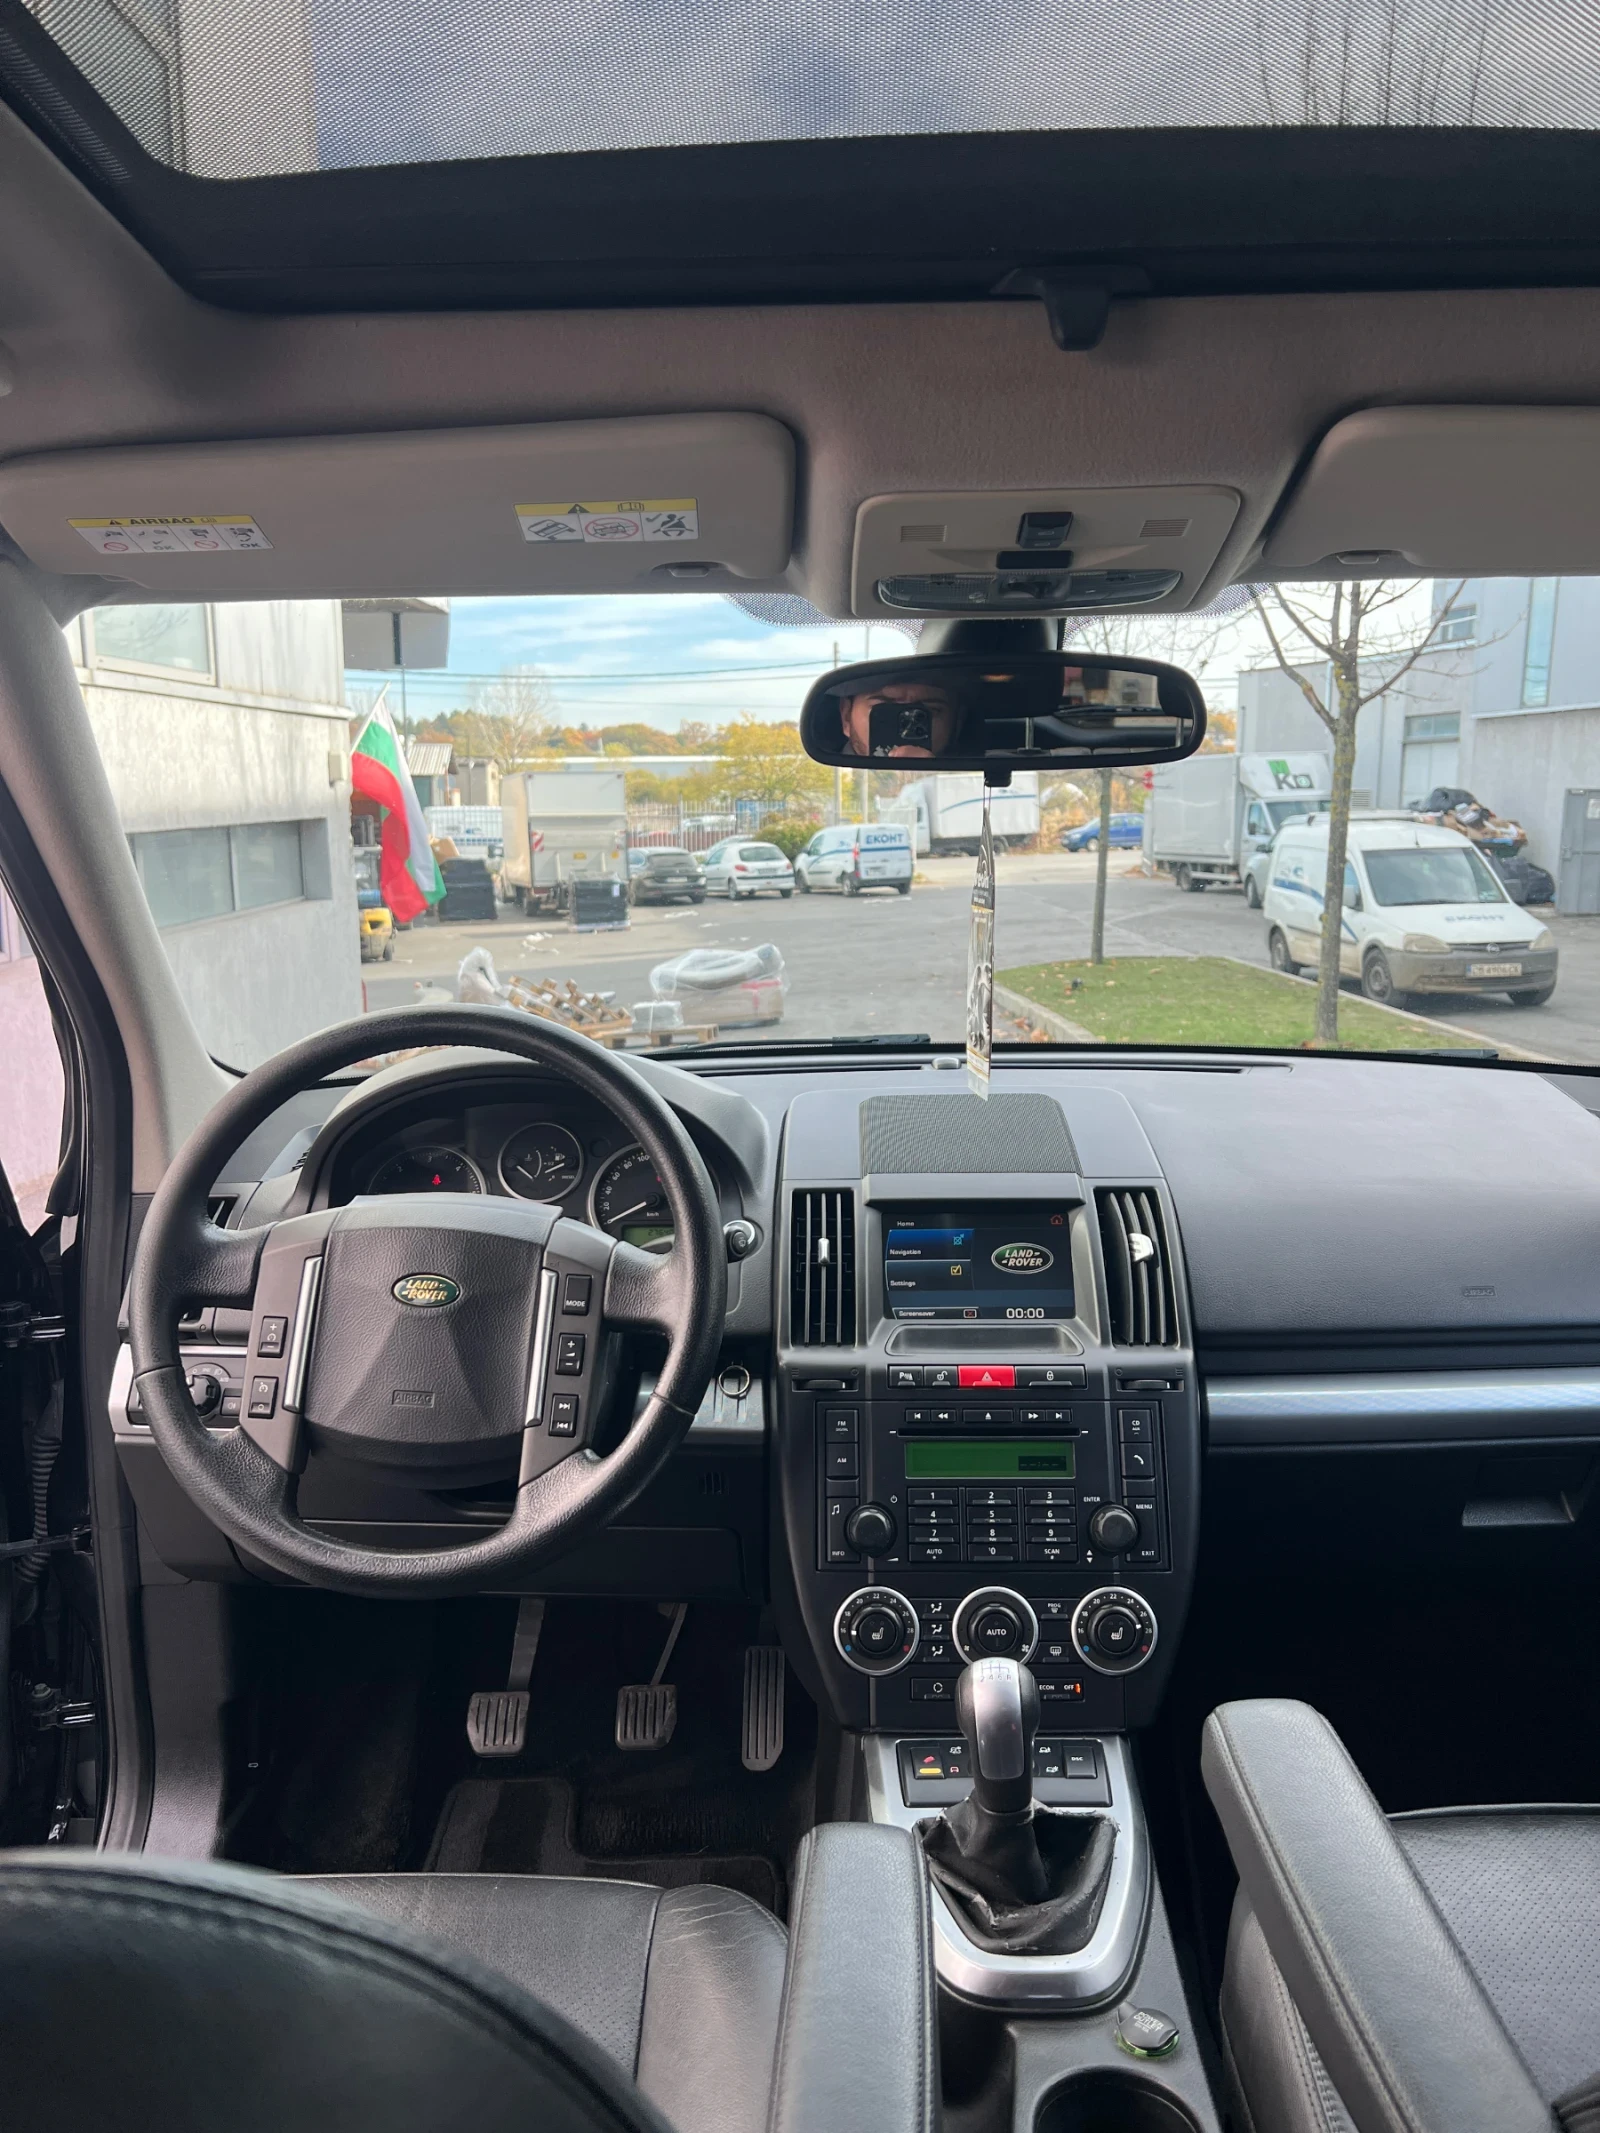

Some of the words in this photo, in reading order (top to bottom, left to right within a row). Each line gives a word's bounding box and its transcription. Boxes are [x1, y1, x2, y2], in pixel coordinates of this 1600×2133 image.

[130, 517, 195, 525] AIRBAG
[637, 1154, 650, 1162] 100
[624, 1161, 632, 1170] 80
[612, 1172, 620, 1181] 60
[605, 1186, 612, 1195] 40
[604, 1201, 610, 1210] 20
[1006, 1308, 1044, 1318] 00:00
[930, 1492, 935, 1500] 1
[989, 1491, 994, 1499] 2
[1047, 1491, 1053, 1499] 3
[930, 1510, 936, 1518] 4
[989, 1510, 995, 1518] 5
[1047, 1510, 1053, 1518] 6
[932, 1529, 937, 1537] 7
[990, 1529, 996, 1537] 8
[1048, 1529, 1054, 1537] 9
